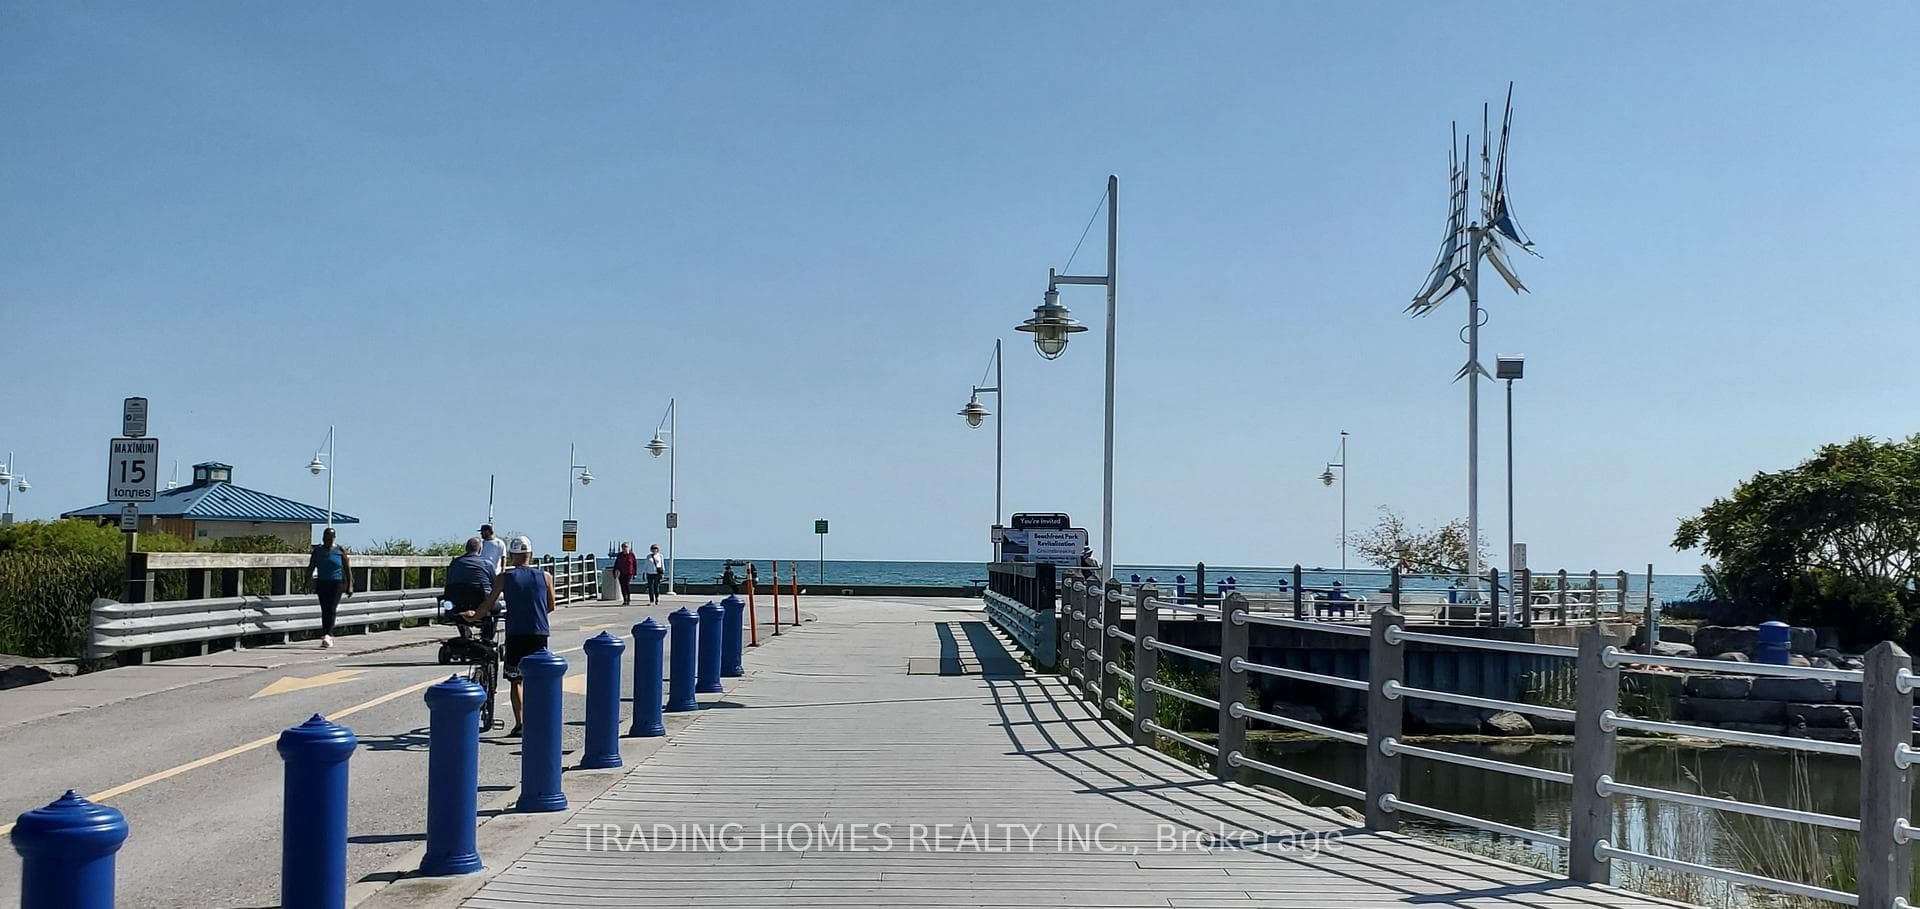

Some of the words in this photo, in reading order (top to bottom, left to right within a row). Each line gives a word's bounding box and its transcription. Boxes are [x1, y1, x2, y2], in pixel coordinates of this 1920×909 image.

[114, 443, 154, 453] MAXIMUM
[121, 460, 146, 483] 15
[114, 488, 151, 497] tonnes
